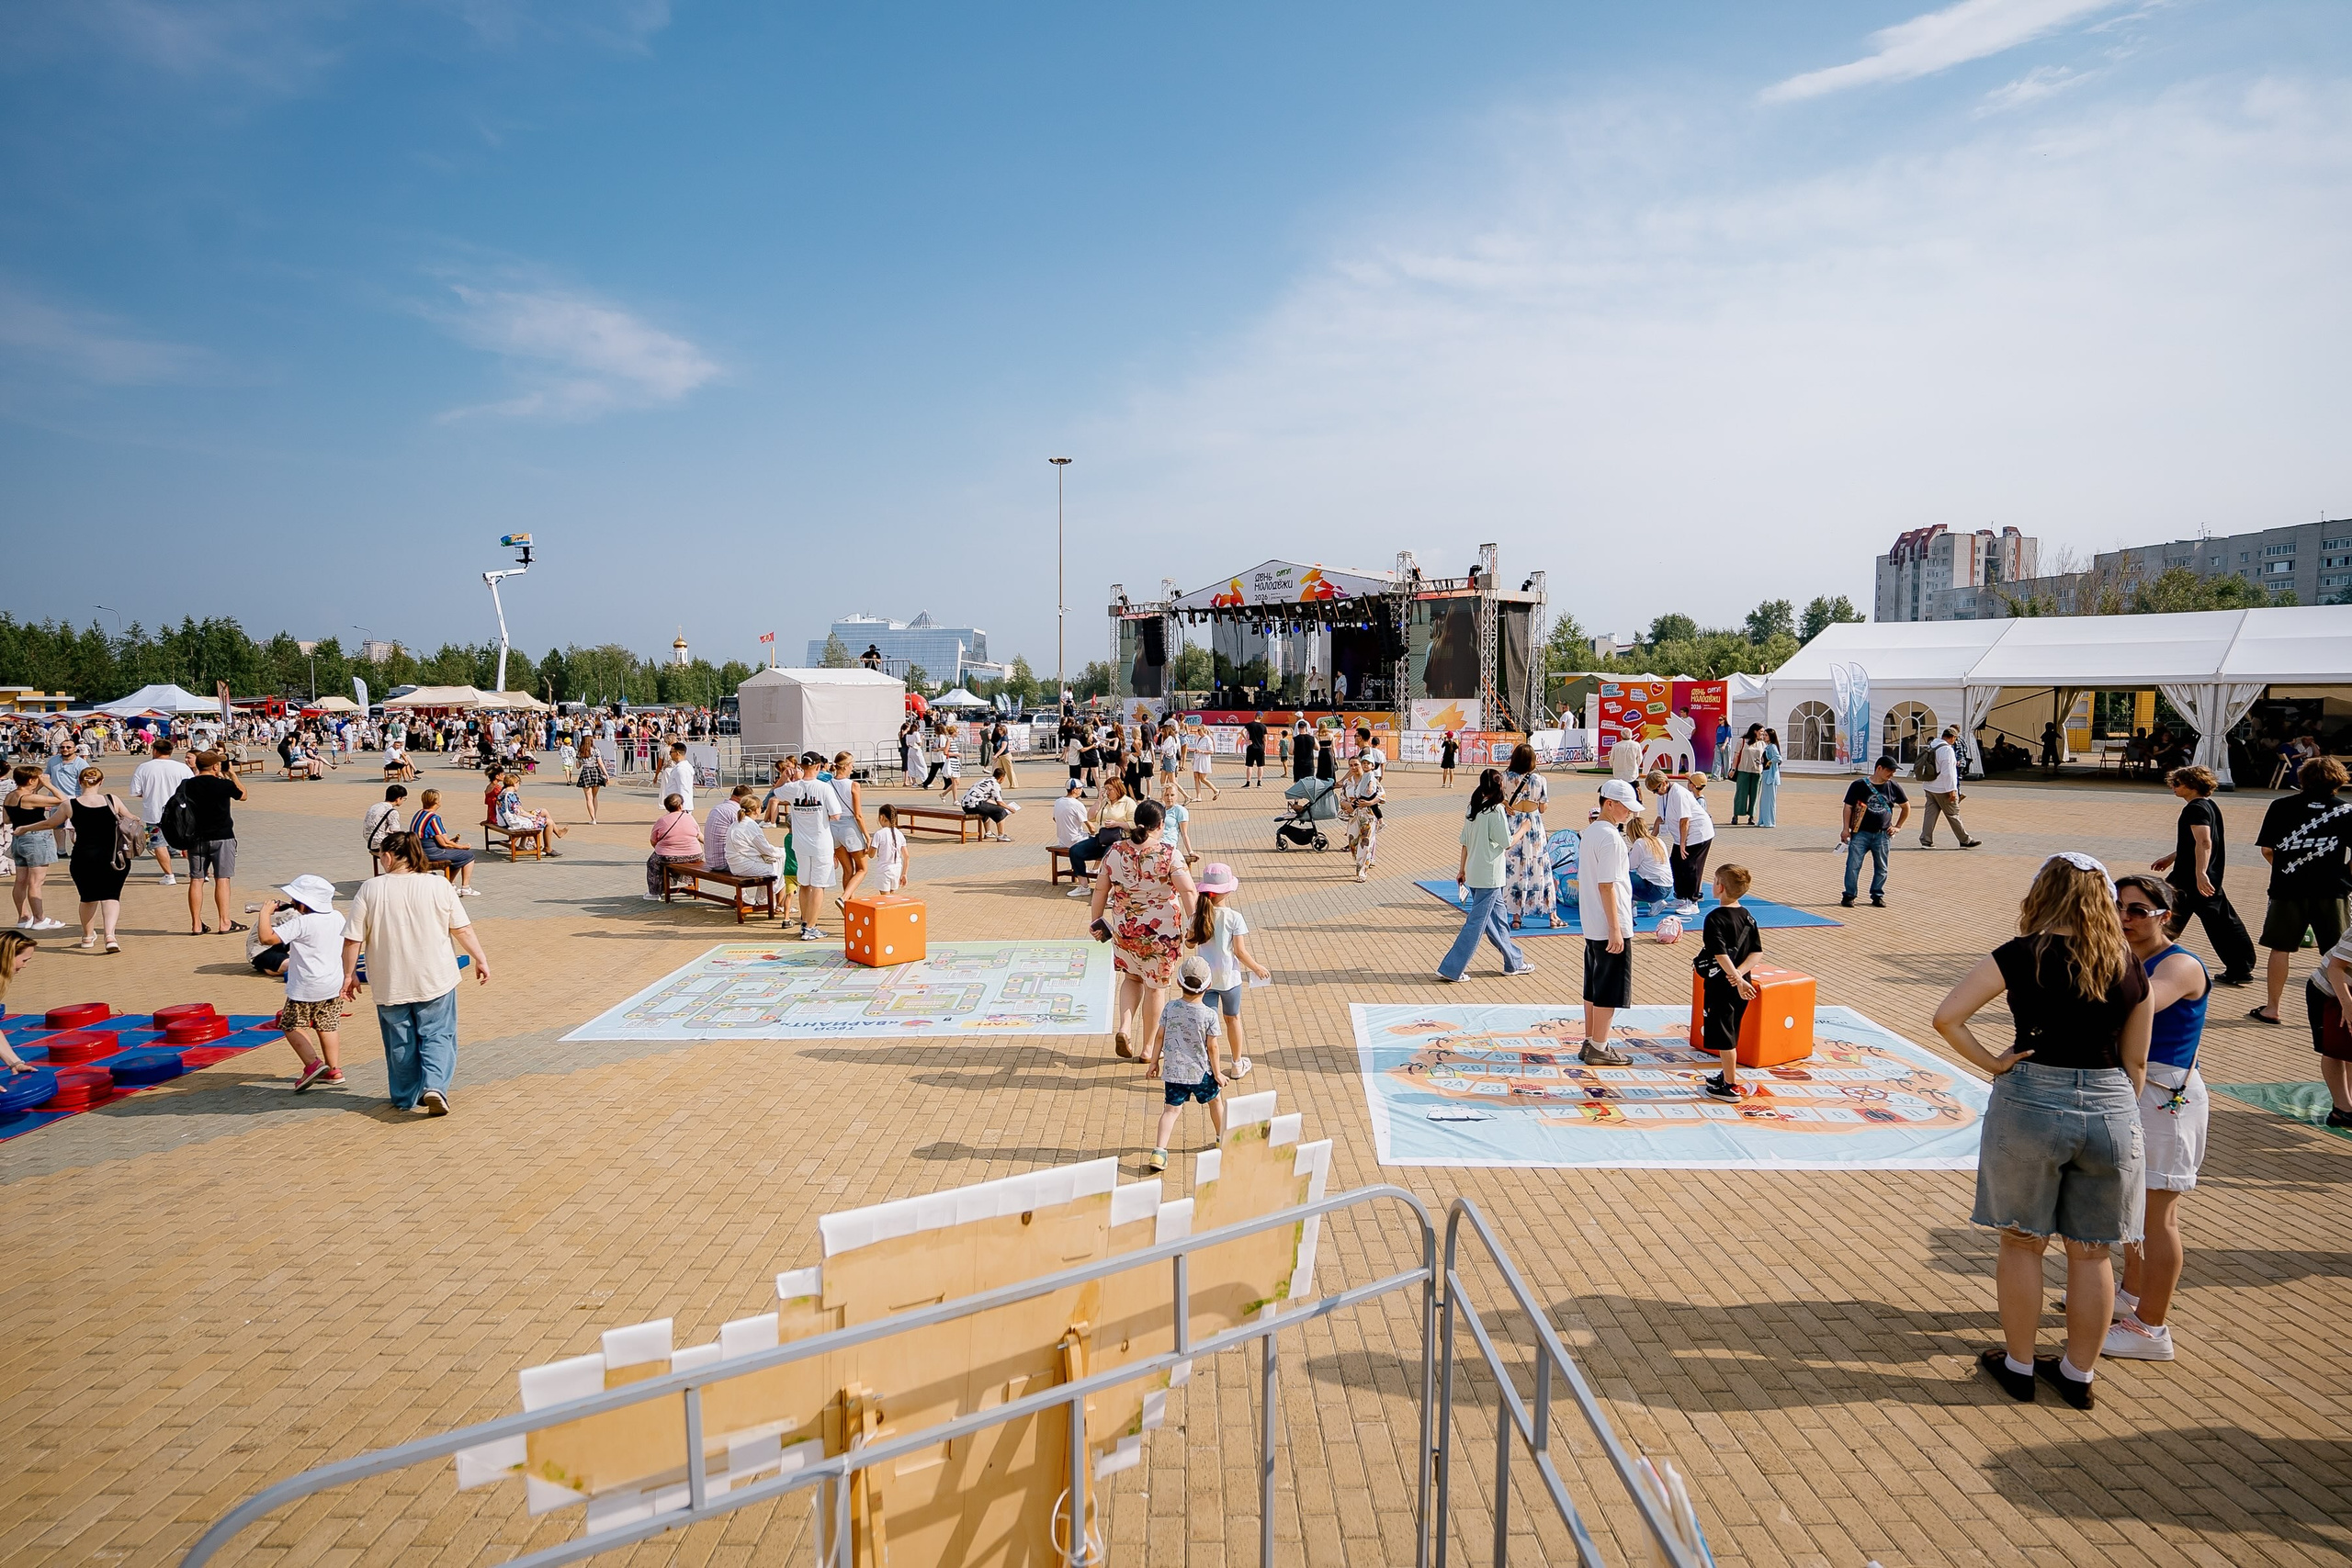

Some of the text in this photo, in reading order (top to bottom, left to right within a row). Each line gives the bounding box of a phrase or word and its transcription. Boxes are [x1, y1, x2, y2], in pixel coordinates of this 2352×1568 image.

[1254, 572, 1272, 582] ДЕНЬ
[1254, 579, 1294, 592] МОЛОДЁЖИ
[1566, 750, 1581, 761] 2026
